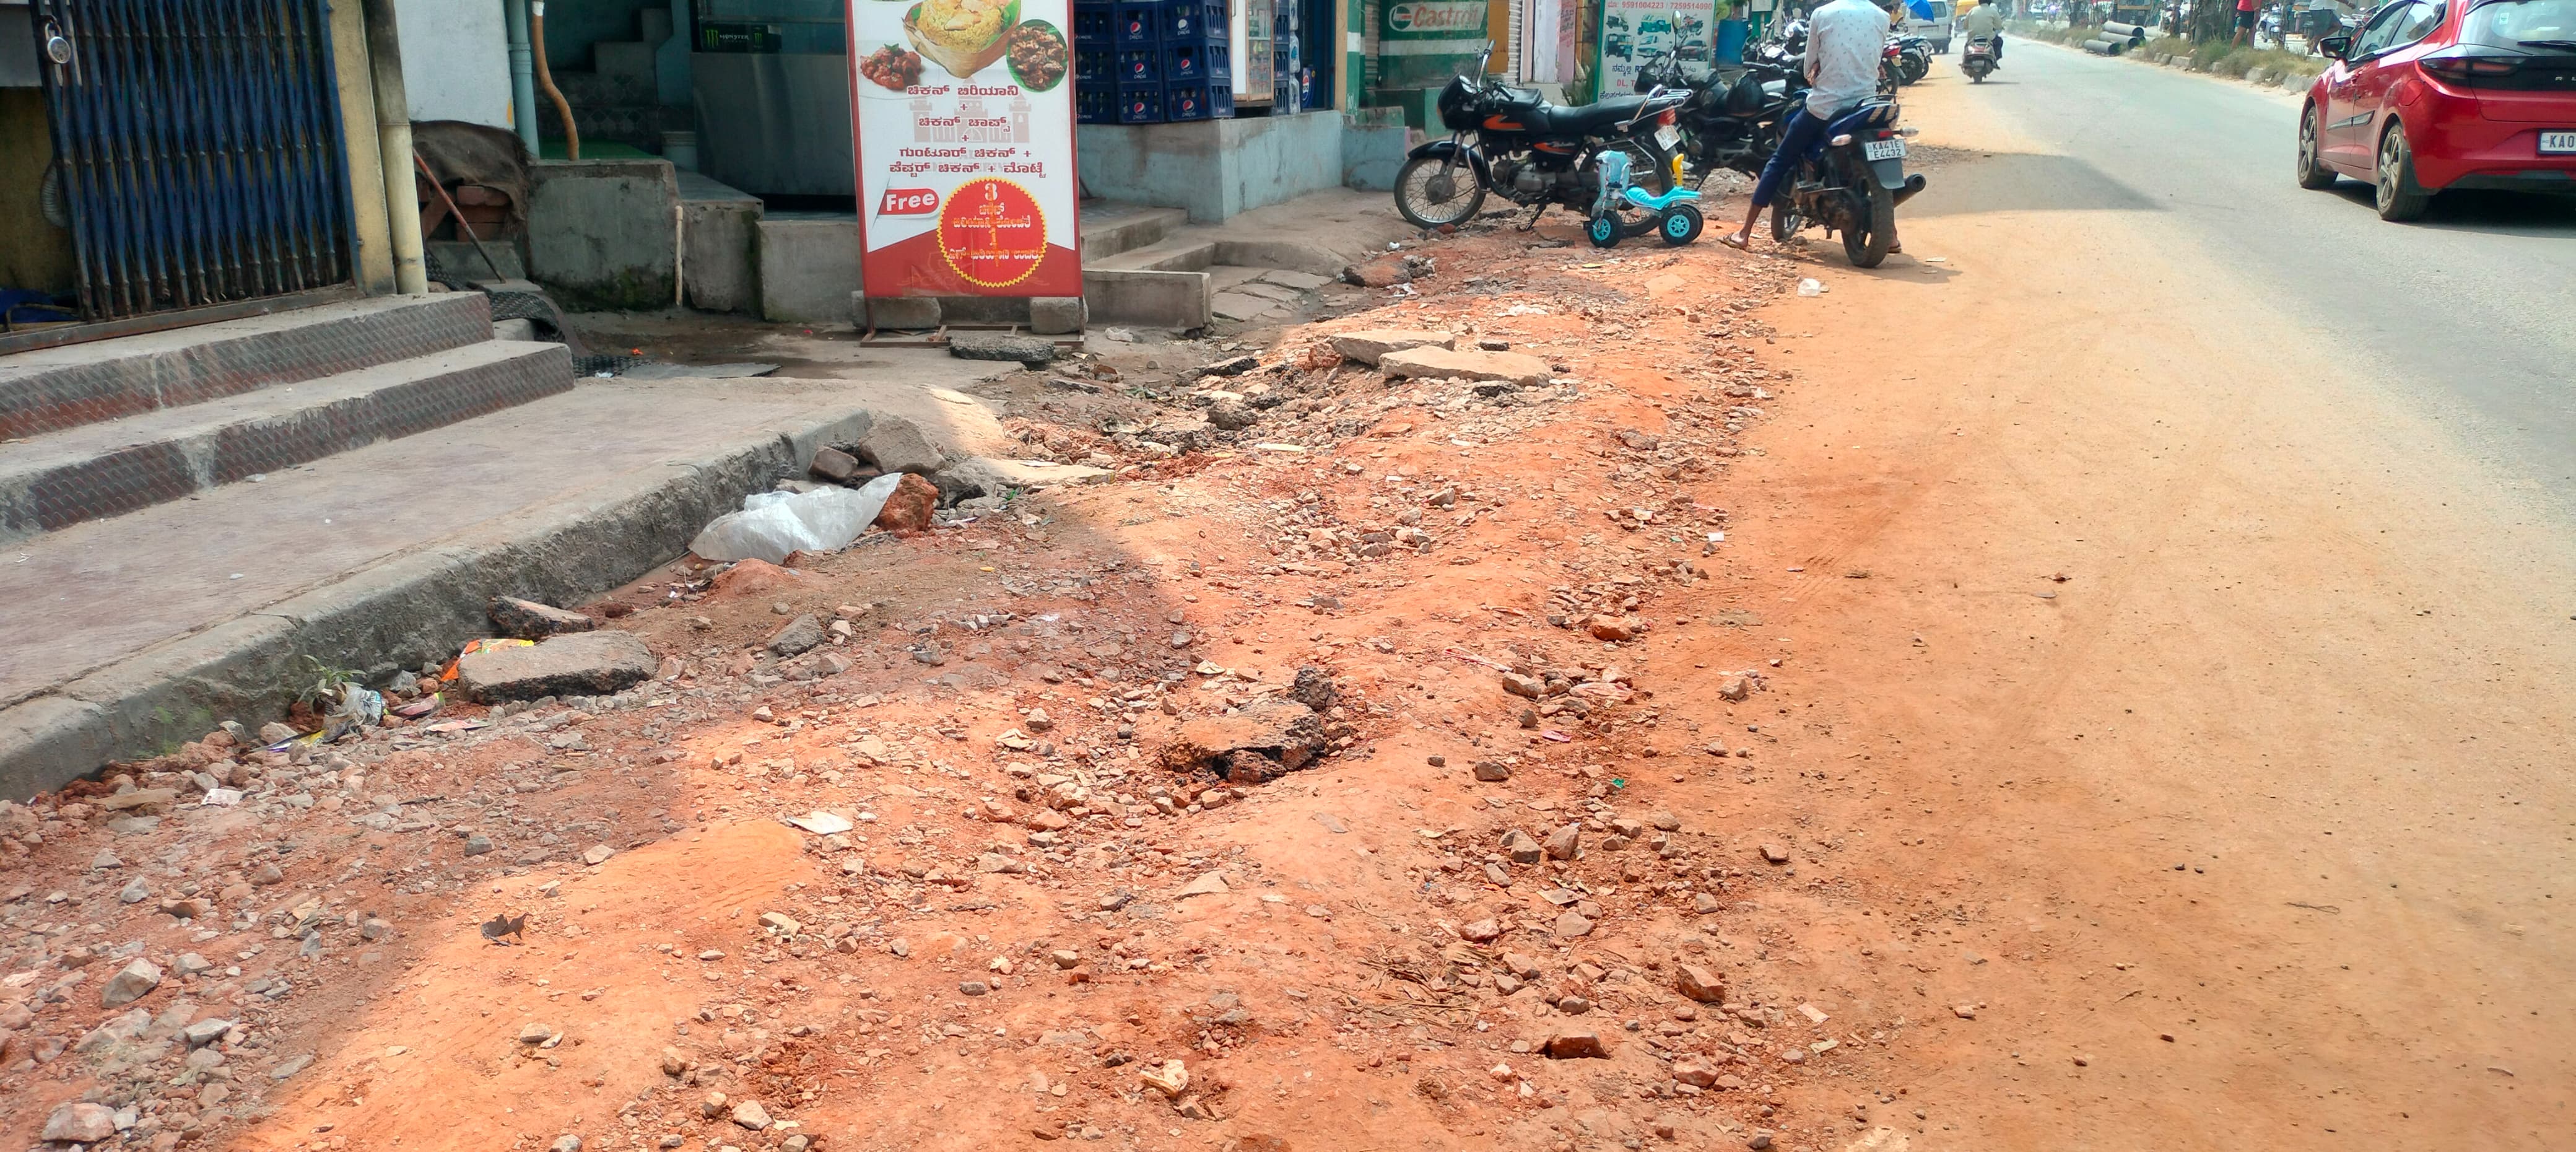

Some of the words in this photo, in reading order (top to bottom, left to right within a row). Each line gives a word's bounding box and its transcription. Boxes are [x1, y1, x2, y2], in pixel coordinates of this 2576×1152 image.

[907, 85, 951, 95] ಚಿಕನ್
[957, 85, 1019, 96] ಬಿರಿಯಾನಿ
[918, 116, 961, 126] ಚಿಕನ್
[968, 116, 1011, 133] ಚಾಪ್ಸ್
[899, 147, 967, 157] ಗುಂಟೂರ್
[974, 147, 1016, 158] ಚಿಕನ್
[1873, 140, 1900, 151] KA41E
[1874, 148, 1902, 159] E4432
[889, 160, 931, 178] ಪೆಪ್ಪರ್
[938, 162, 980, 173] ಚಿಕನ್
[984, 182, 998, 201] 3
[886, 193, 935, 211] Free
